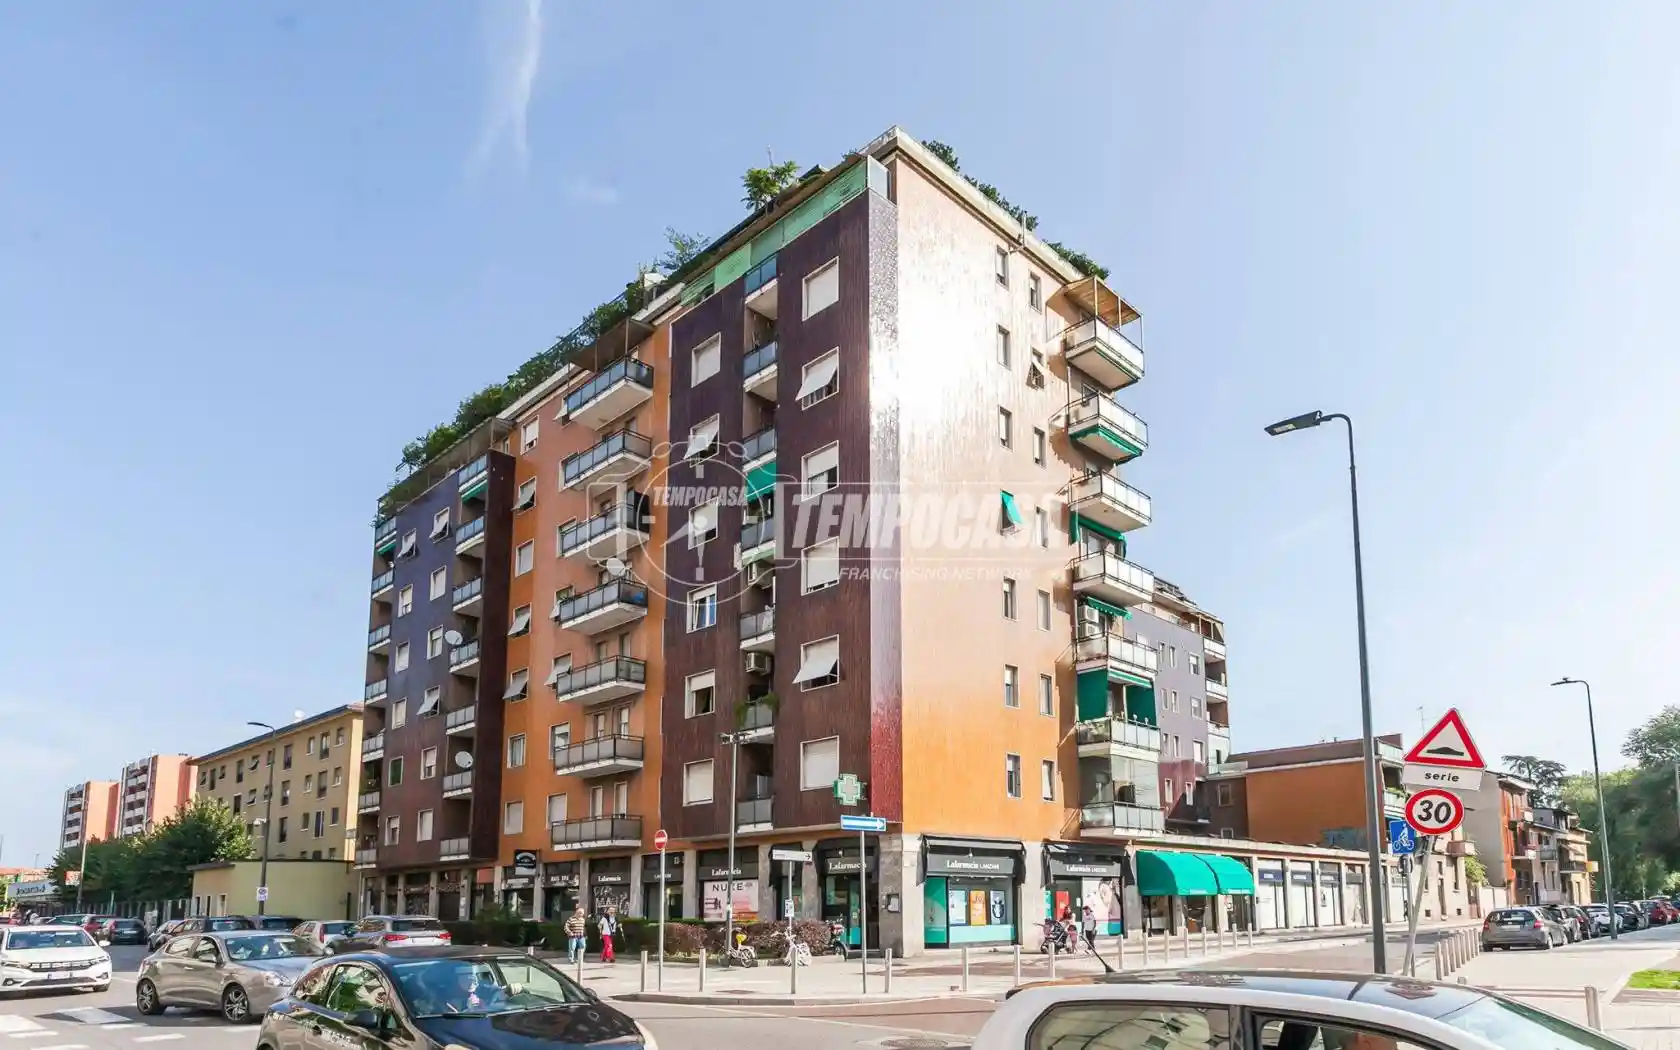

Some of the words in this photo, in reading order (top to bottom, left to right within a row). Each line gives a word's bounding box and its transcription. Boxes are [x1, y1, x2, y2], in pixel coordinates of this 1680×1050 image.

[1425, 772, 1460, 782] serie
[1418, 800, 1451, 824] 30
[829, 860, 867, 870] Lafarmaca
